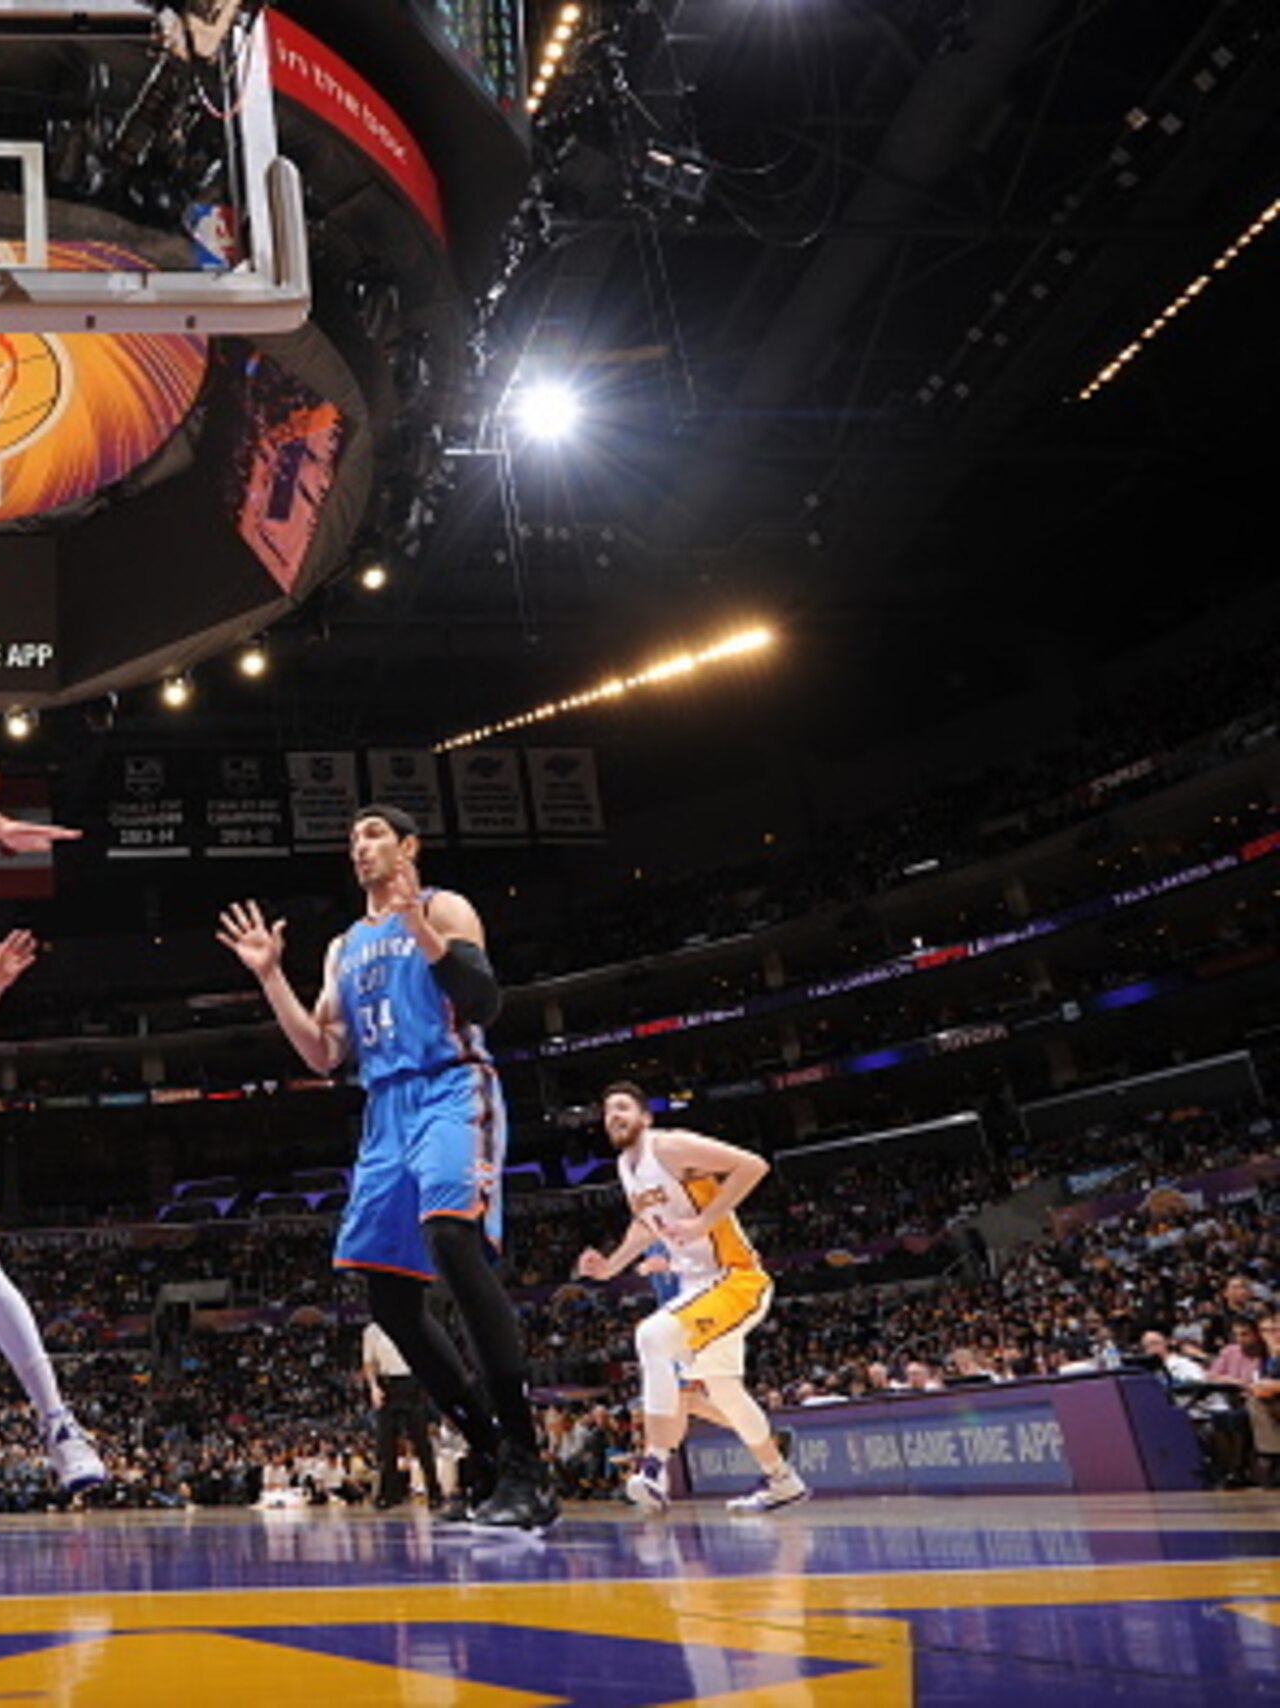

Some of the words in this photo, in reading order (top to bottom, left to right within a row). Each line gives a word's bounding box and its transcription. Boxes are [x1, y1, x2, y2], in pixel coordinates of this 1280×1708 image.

[275, 37, 309, 78] in
[312, 62, 360, 118] the
[6, 643, 54, 668] APP
[359, 999, 395, 1047] 34
[865, 1434, 902, 1470] NBA
[903, 1430, 961, 1468] GAME
[959, 1426, 1014, 1465] TIME
[1016, 1421, 1065, 1464] APP
